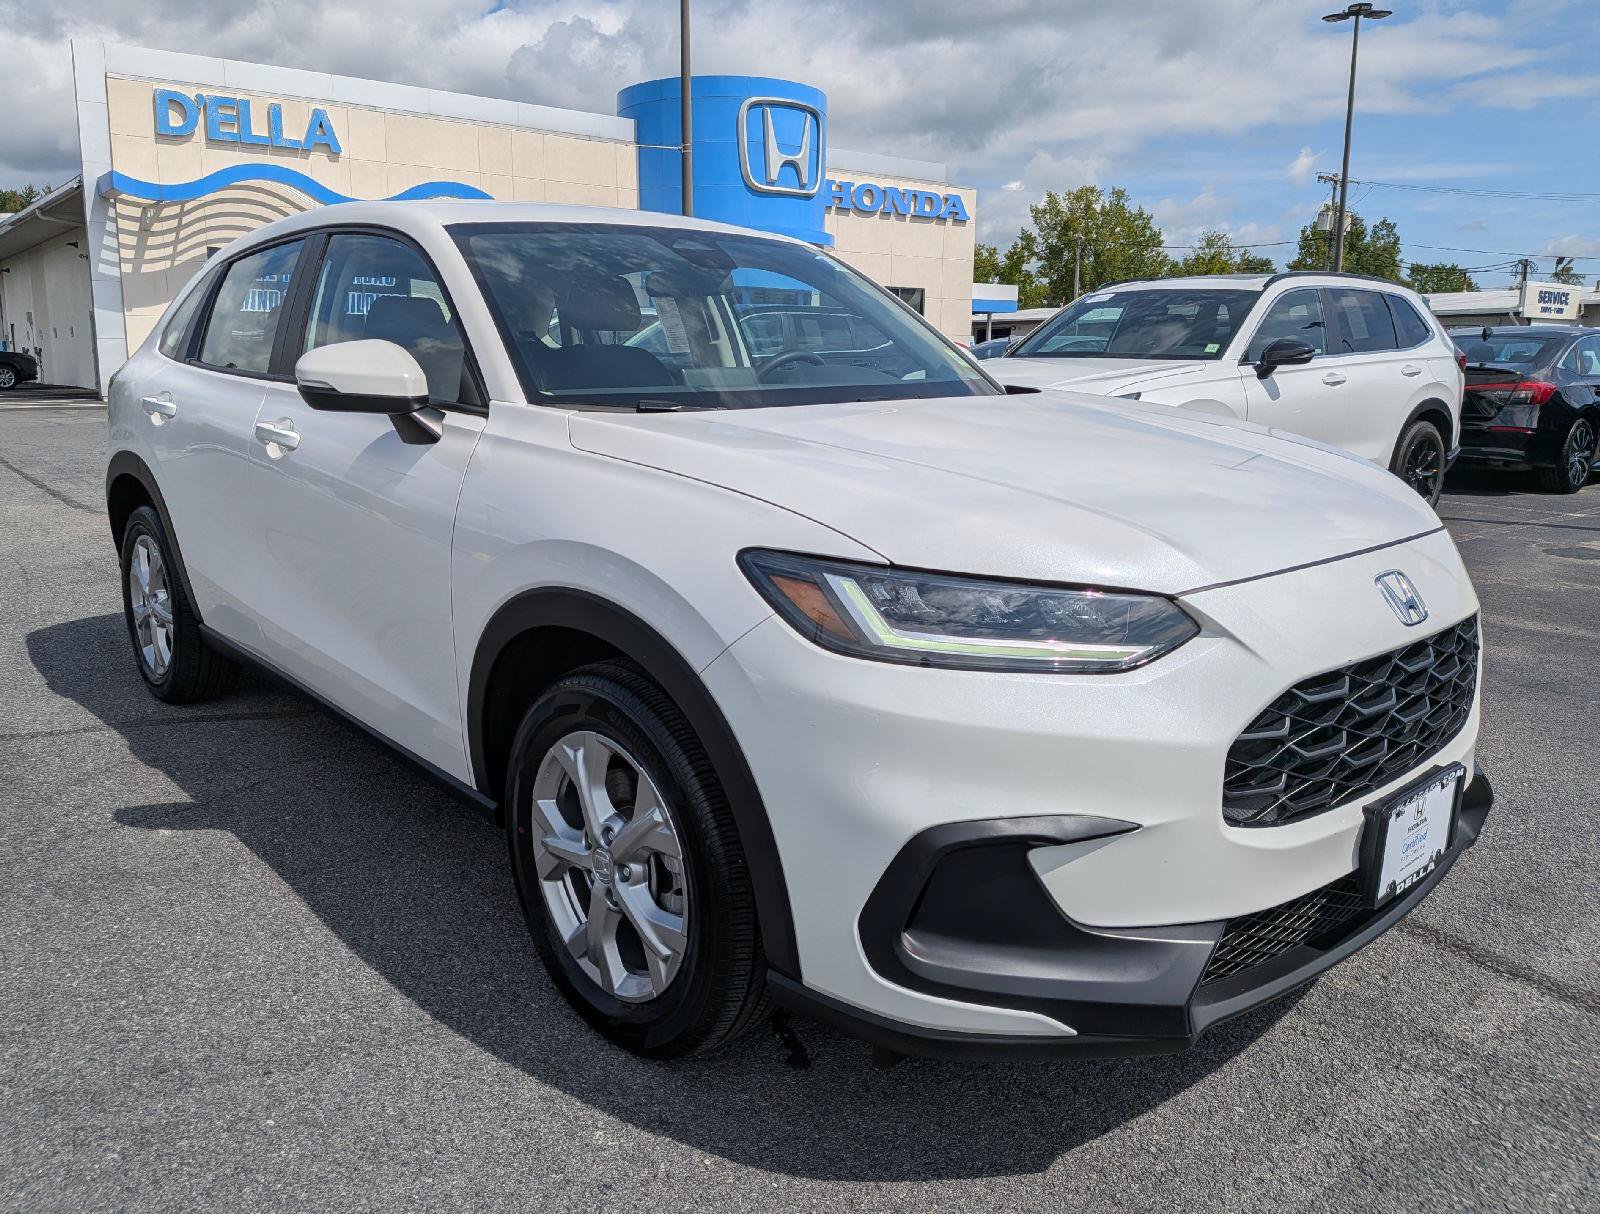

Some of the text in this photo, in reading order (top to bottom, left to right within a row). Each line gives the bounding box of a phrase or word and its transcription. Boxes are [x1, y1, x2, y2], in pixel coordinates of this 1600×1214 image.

[154, 88, 342, 153] D'ELLA
[825, 179, 970, 220] HONDA
[1538, 290, 1570, 305] SERVICE
[1402, 828, 1428, 854] Certified
